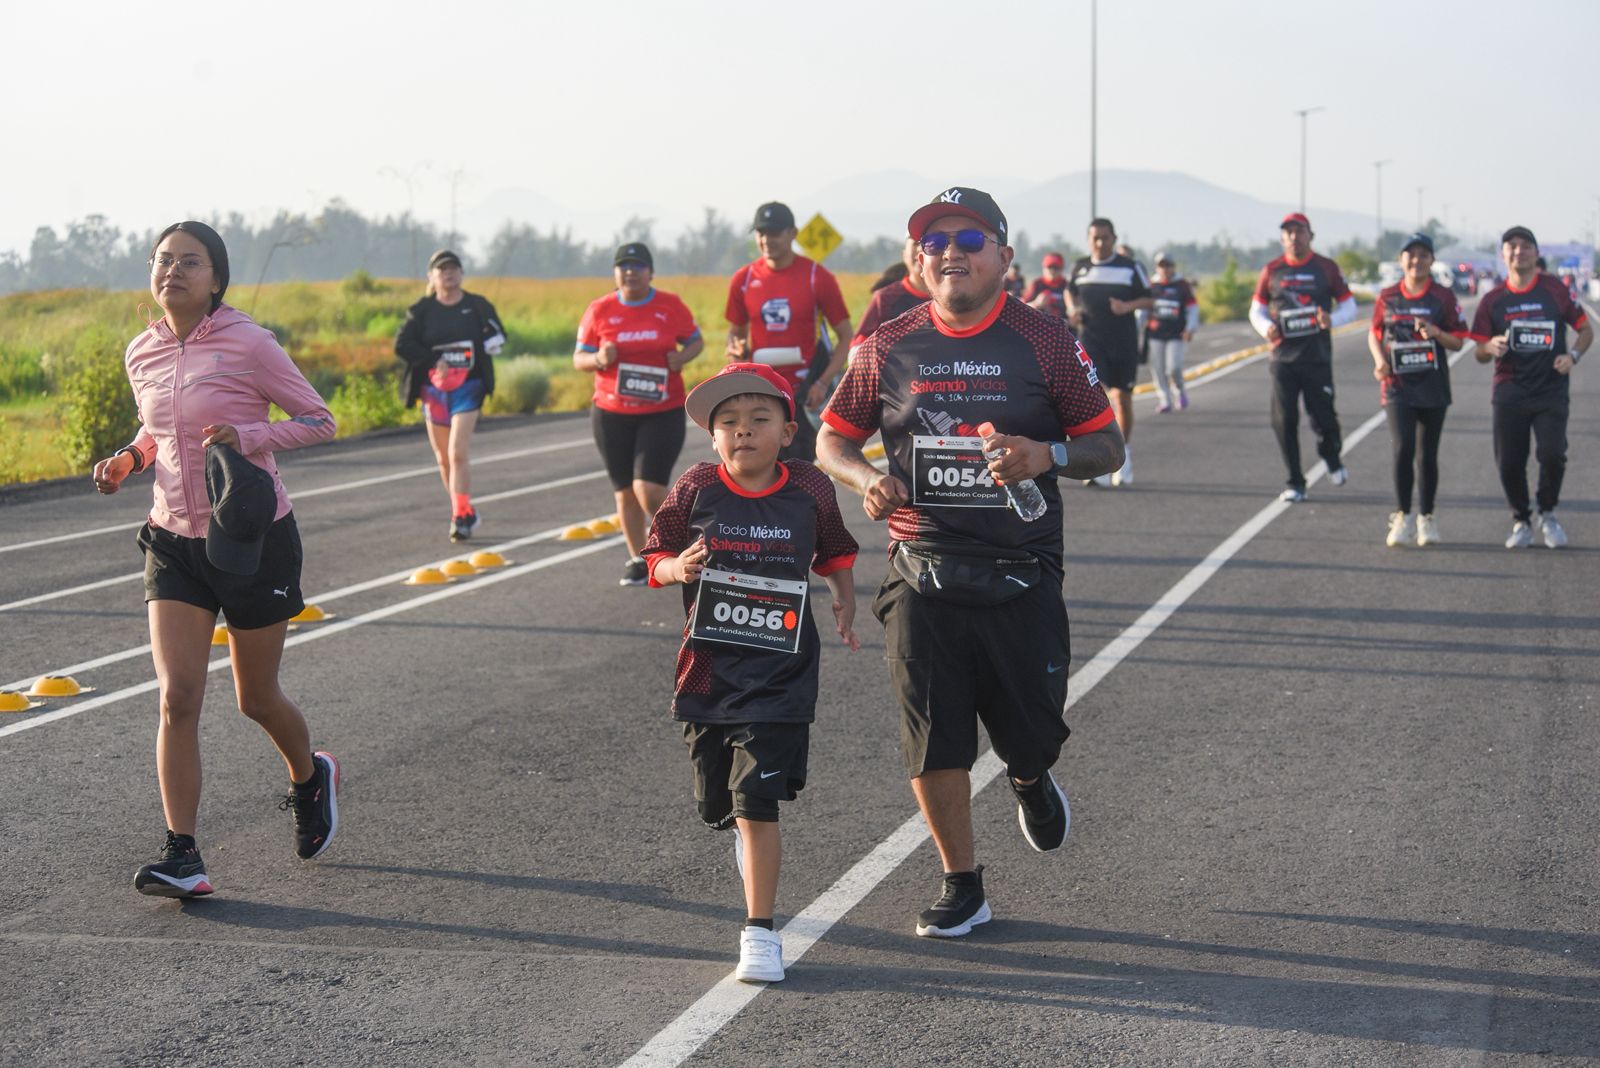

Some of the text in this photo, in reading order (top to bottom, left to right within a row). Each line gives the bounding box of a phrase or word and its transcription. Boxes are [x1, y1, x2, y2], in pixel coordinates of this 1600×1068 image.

[617, 330, 658, 342] SEARS
[1519, 333, 1545, 345] 0127
[918, 361, 1001, 376] Todo México
[626, 378, 656, 392] 0189
[910, 378, 1008, 395] Salvando Vidas
[948, 393, 963, 402] 10k
[965, 394, 970, 402] y
[971, 393, 1007, 402] caminata
[936, 453, 956, 461] México
[928, 466, 994, 488] 0054
[717, 523, 791, 539] Todo México
[710, 536, 796, 553] Salvando Vidas
[744, 553, 757, 561] 10k
[764, 555, 795, 563] caminata
[726, 590, 747, 598] México
[713, 601, 784, 631] 0056
[719, 626, 786, 642] Fundación Coppel
